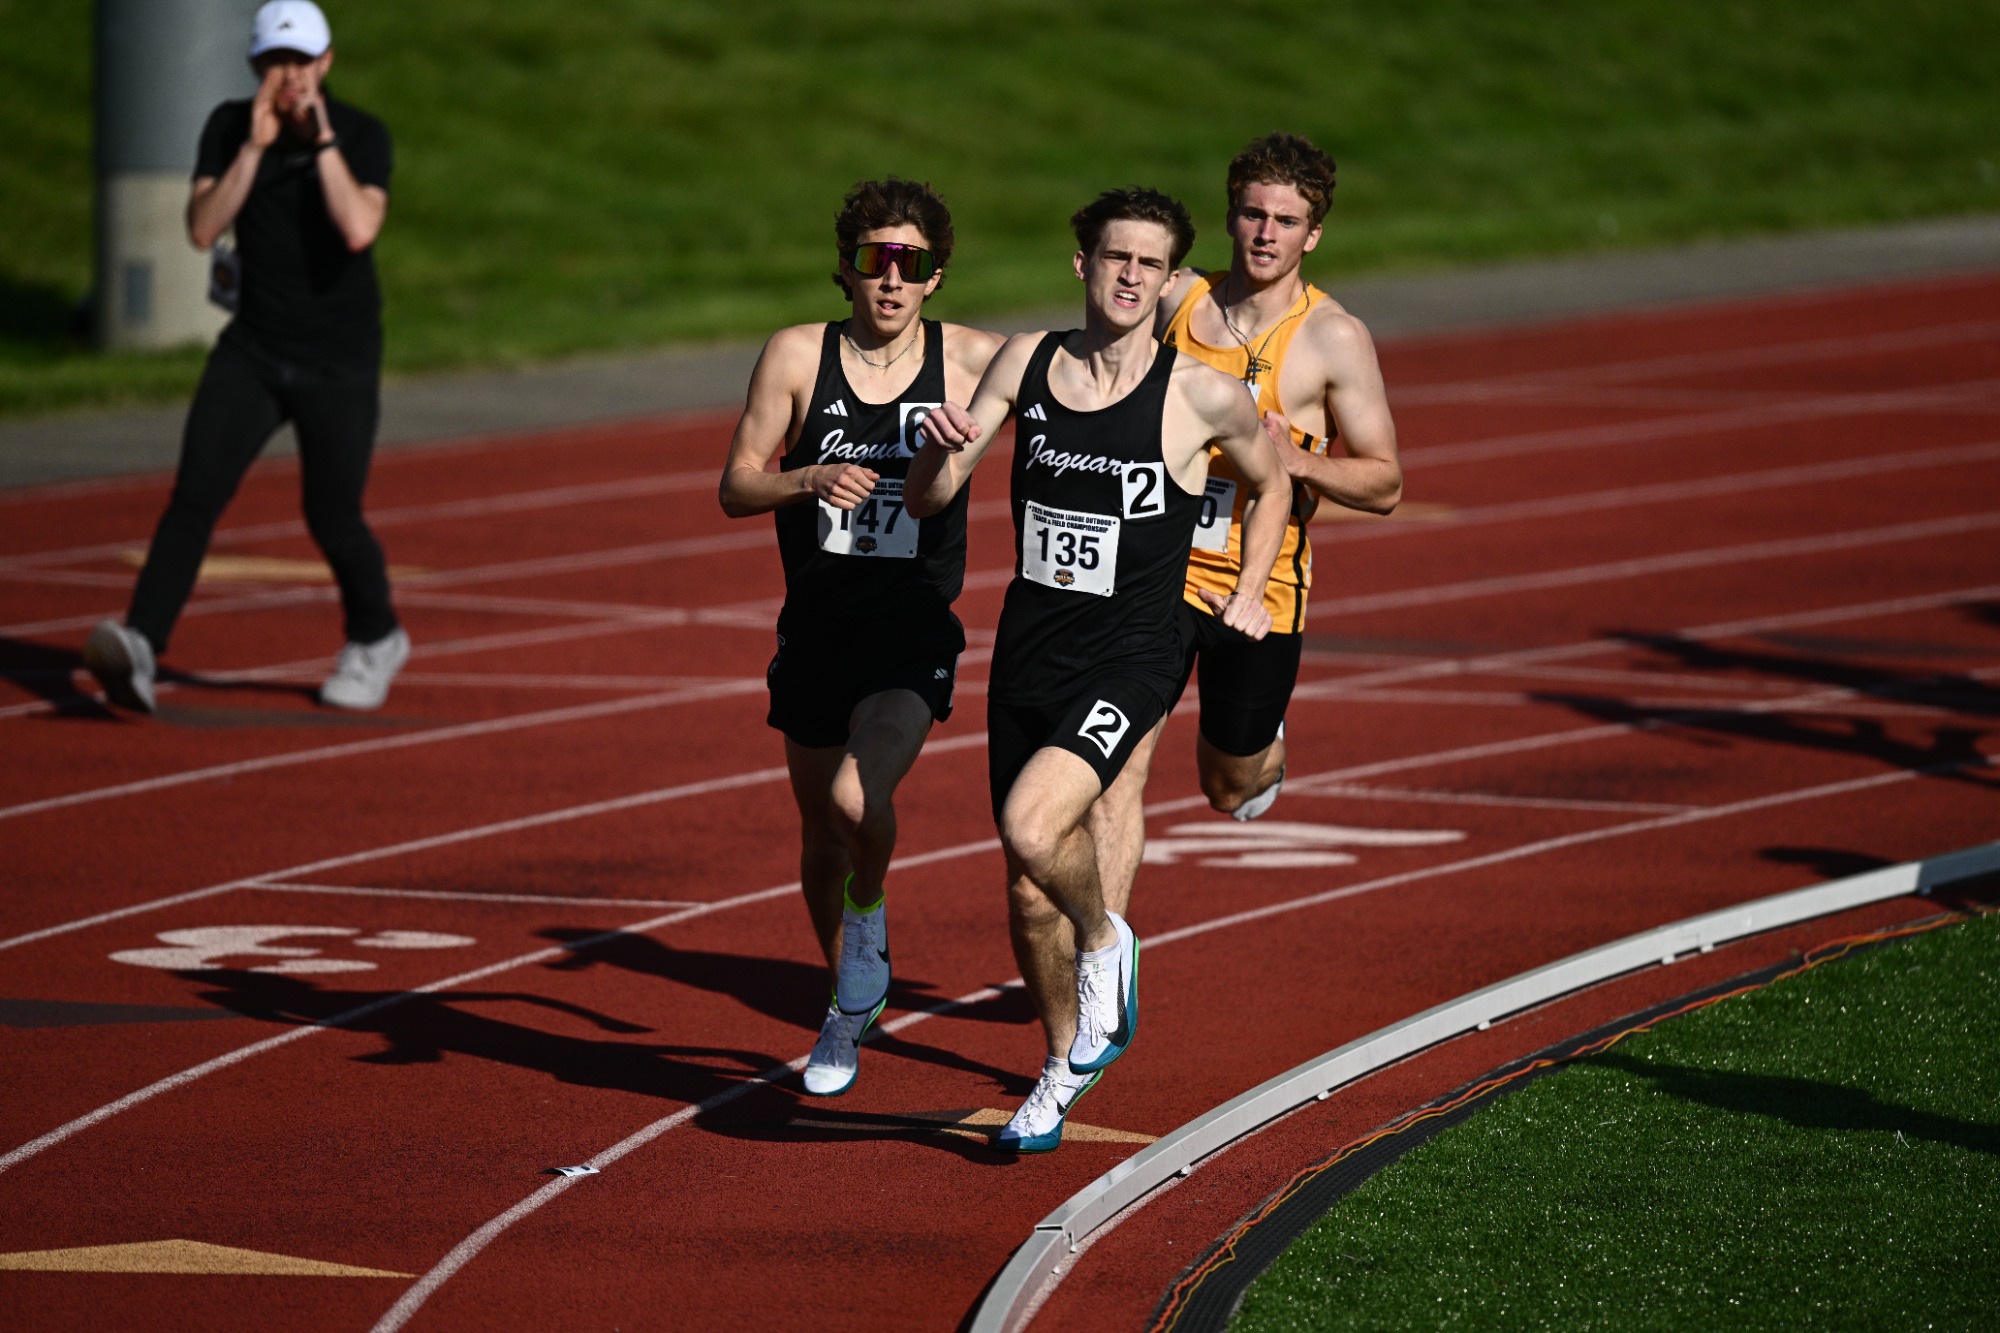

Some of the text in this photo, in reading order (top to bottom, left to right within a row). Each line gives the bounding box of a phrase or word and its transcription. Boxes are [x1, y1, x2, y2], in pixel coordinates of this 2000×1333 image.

[818, 429, 900, 465] Jagua
[905, 406, 932, 454] 6
[1026, 434, 1135, 477] Jaguar
[1127, 467, 1158, 514] 2
[840, 499, 904, 534] 147
[1033, 513, 1047, 524] TRACK
[1052, 519, 1066, 528] FIELD
[1066, 522, 1109, 534] CHAMPIONSHIP
[1043, 509, 1065, 520] HORIZON
[1065, 513, 1085, 523] LEAGUE
[1085, 516, 1112, 527] OUTDOOR
[1036, 527, 1101, 571] 135
[1085, 706, 1122, 750] 2
